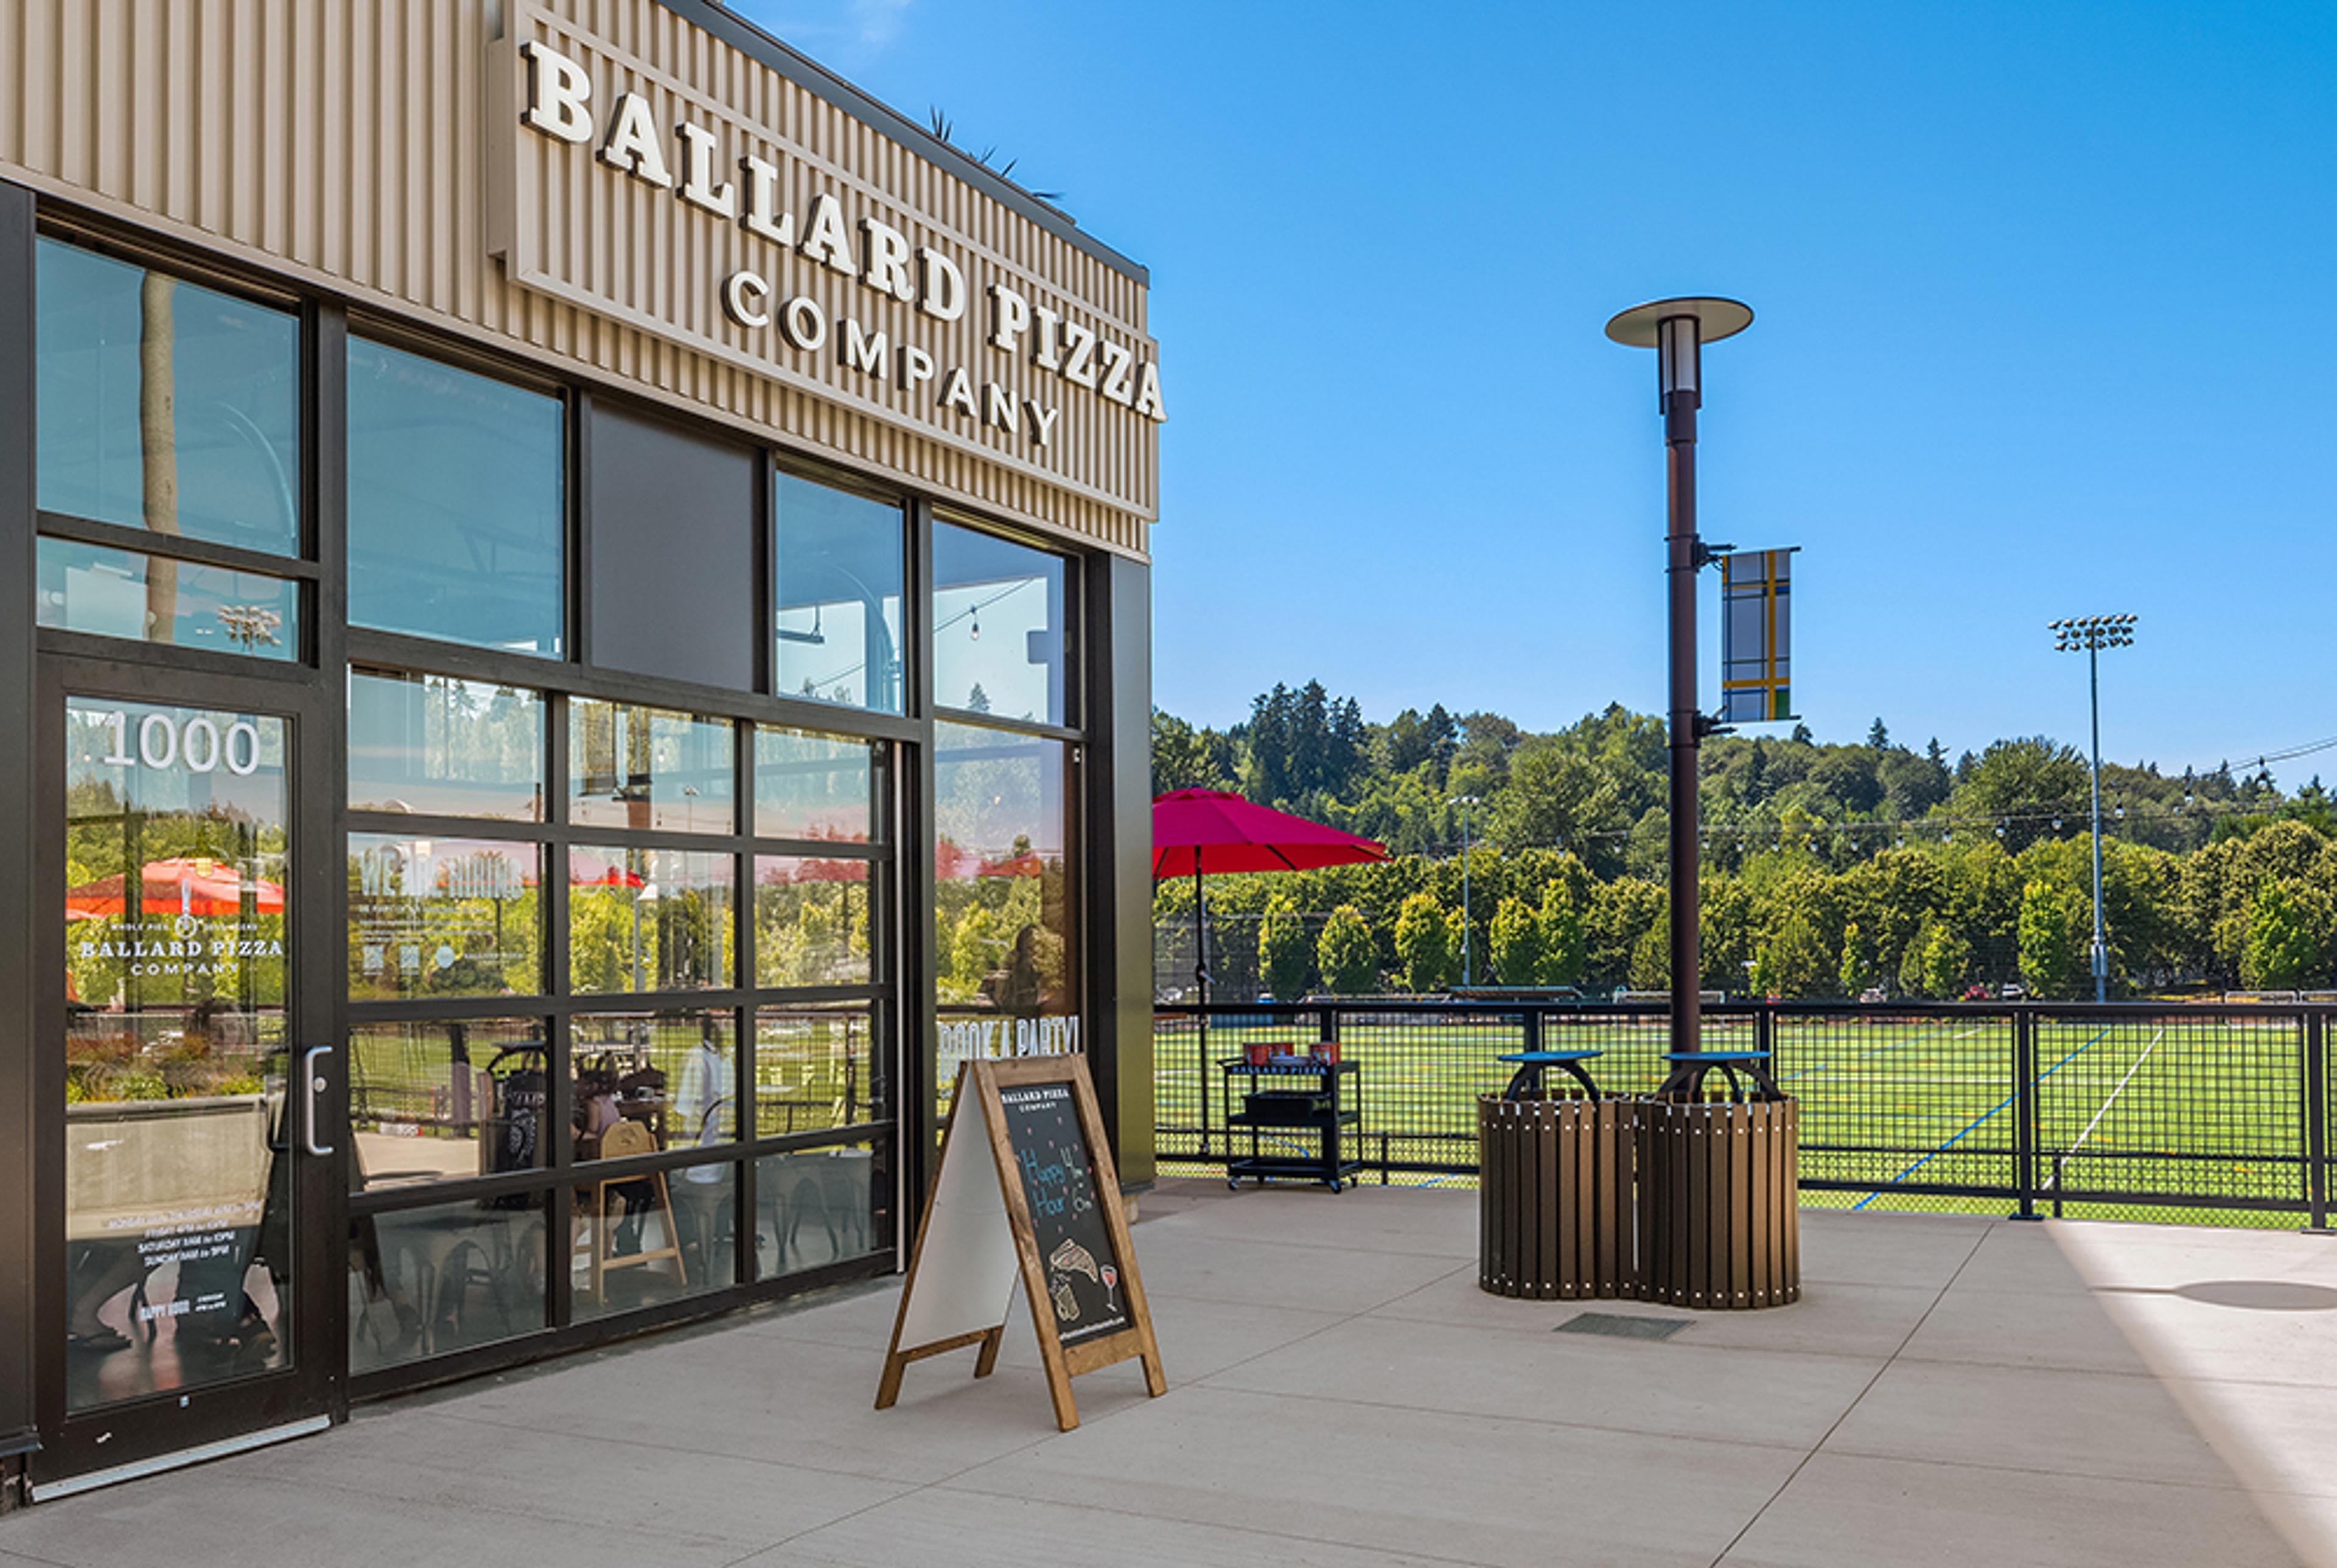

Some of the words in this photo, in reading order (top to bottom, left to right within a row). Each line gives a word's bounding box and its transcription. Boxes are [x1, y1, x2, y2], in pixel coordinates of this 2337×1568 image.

[521, 40, 965, 322] BALLARD
[988, 282, 1167, 423] PIZZA
[723, 270, 1059, 447] COMPANY
[101, 711, 260, 775] 1000
[80, 941, 202, 958] BALLARD
[212, 940, 284, 956] PIZZA
[130, 963, 239, 977] COMPANY
